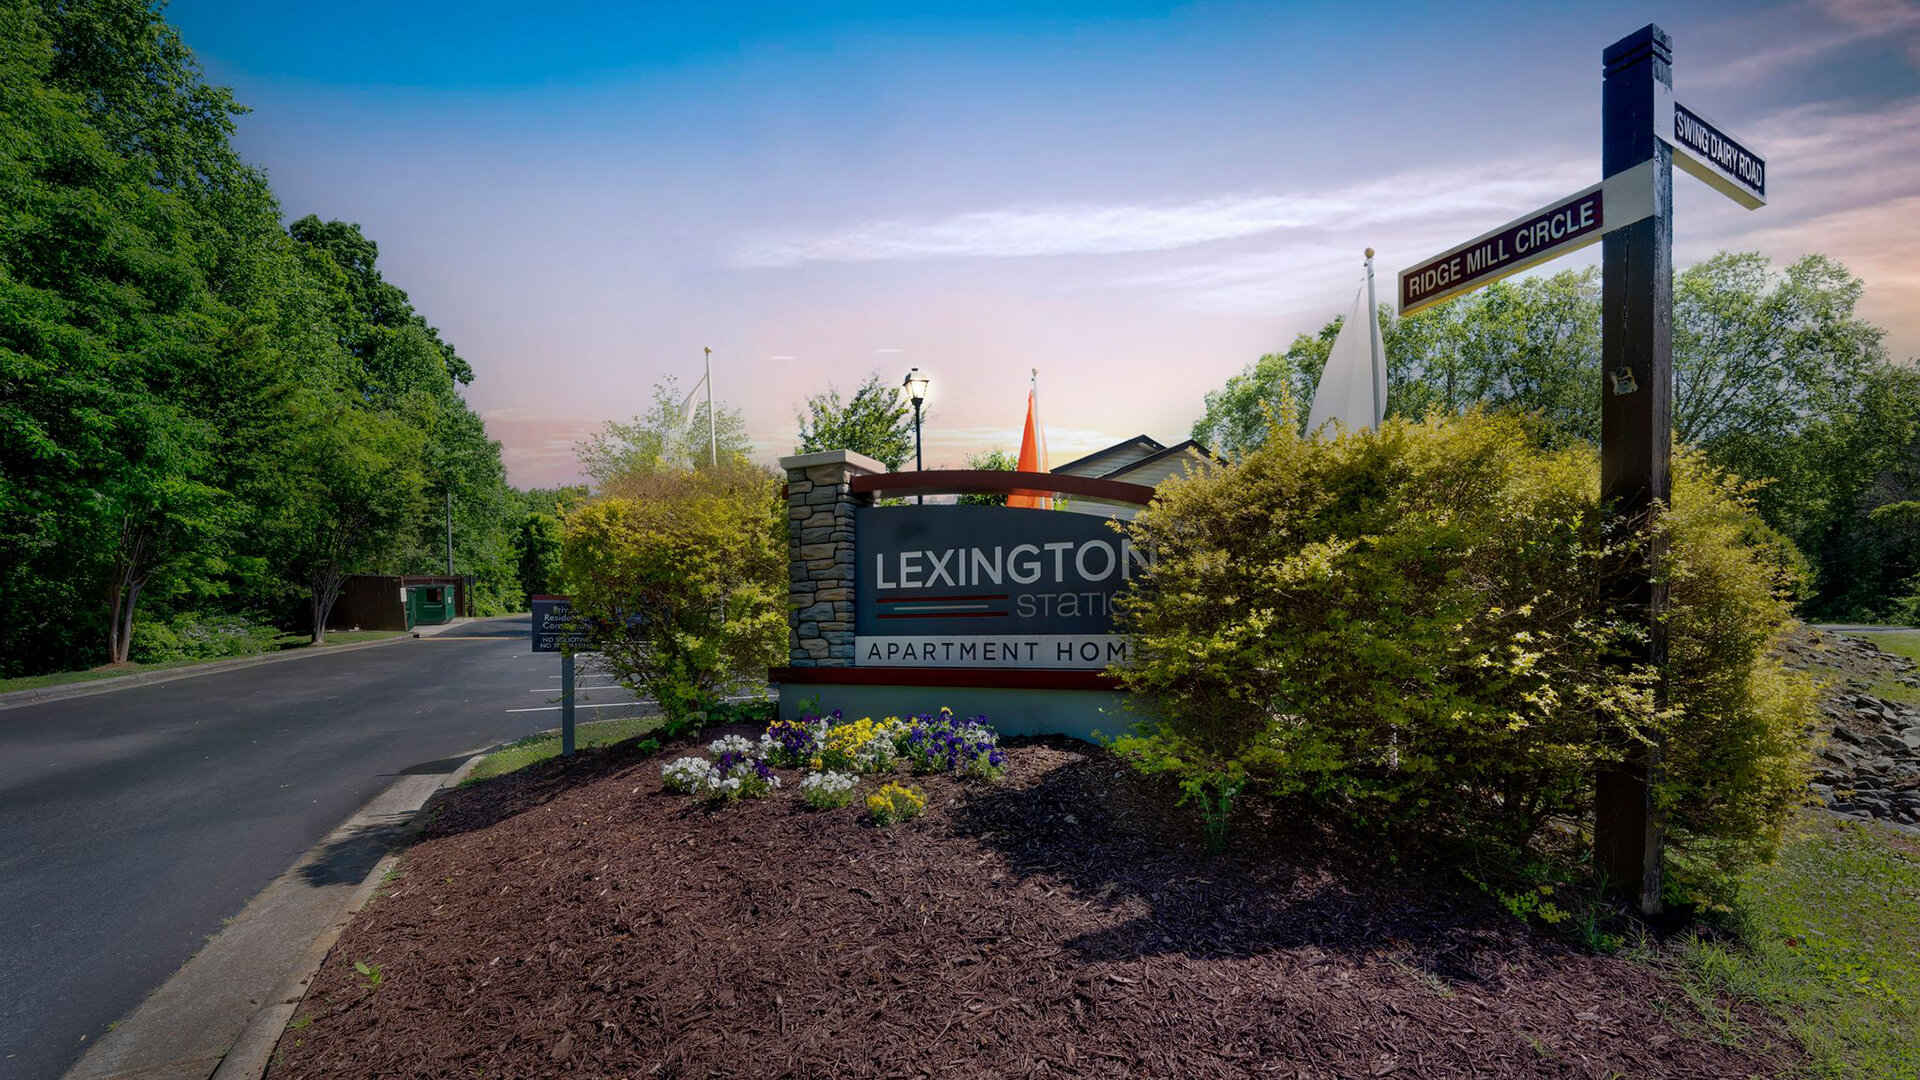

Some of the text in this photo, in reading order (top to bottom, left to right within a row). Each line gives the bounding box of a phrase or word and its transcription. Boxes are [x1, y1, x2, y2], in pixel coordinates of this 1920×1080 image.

[1675, 111, 1762, 187] SWING DAIRY ROAD
[1409, 201, 1594, 298] RIDGE MILL CIRCLE
[876, 539, 1157, 590] LEXINGTON
[867, 641, 1127, 661] APARTMENT HOM
